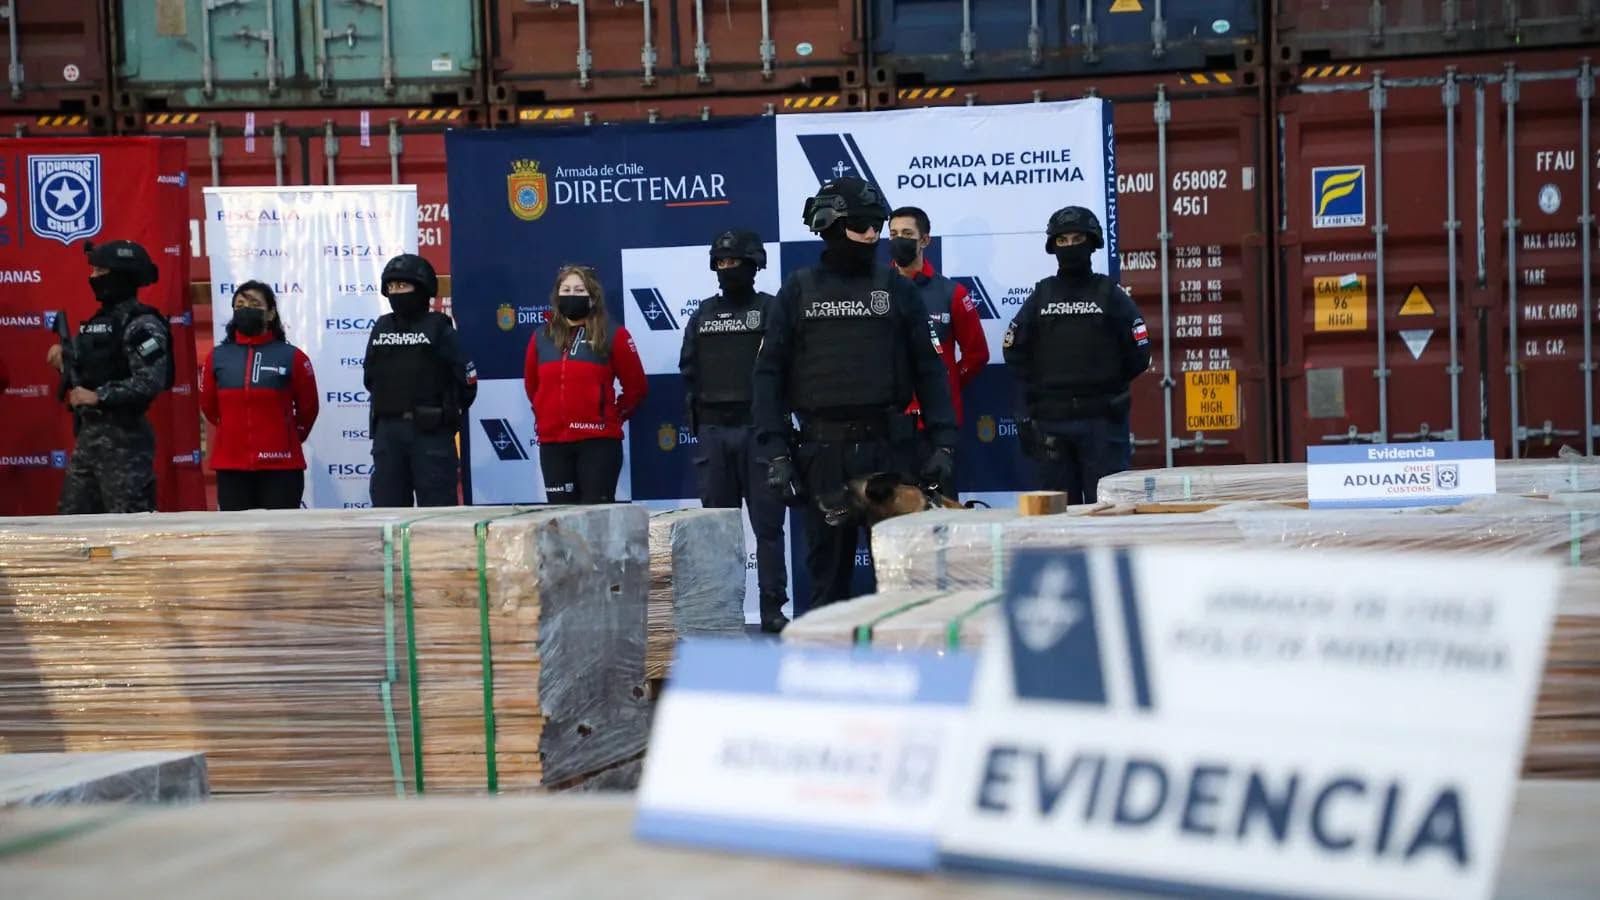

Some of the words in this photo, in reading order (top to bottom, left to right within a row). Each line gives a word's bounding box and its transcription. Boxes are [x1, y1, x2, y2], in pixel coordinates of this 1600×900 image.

[908, 154, 987, 170] ARMADA
[992, 153, 1015, 166] DE
[1020, 149, 1071, 164] CHILE
[1536, 151, 1575, 171] FFAU
[555, 165, 598, 177] Armada
[601, 164, 614, 176] de
[616, 163, 644, 175] Chile
[898, 172, 977, 189] POLICIA
[984, 167, 1084, 186] MARITIMA
[1117, 173, 1154, 193] GAOU
[1172, 169, 1227, 191] 658082
[554, 173, 727, 205] DIRECTEMAR
[1107, 123, 1117, 257] MARITIMAS
[1172, 195, 1208, 215] 45G1
[418, 226, 442, 246] 5G1
[1548, 232, 1576, 249] GROSS
[1120, 251, 1156, 271] X.GROSS
[1208, 257, 1222, 267] LBS
[1304, 251, 1376, 263] www.florens.co
[1207, 280, 1221, 290] KGS
[811, 301, 865, 310] POLICIA
[1040, 307, 1104, 315] MARITIMA
[1549, 303, 1578, 320] CARGO
[805, 308, 872, 318] MARITIMA
[1328, 313, 1353, 326] HIGH
[0, 316, 41, 326] UANAS
[699, 324, 747, 333] MARITIMA
[1208, 326, 1222, 336] LBS
[372, 337, 431, 346] MARITIMA
[379, 332, 426, 340] POLICIA
[1546, 339, 1566, 356] CAP.
[1191, 374, 1230, 385] CAUTION
[1200, 402, 1223, 414] HIGH
[0, 454, 48, 465] DUANAS
[1367, 446, 1435, 460] Evidencia
[1403, 464, 1431, 473] CHILE
[1343, 473, 1431, 487] ADUANAS
[1387, 486, 1432, 494] CUSTOMS
[974, 741, 1470, 868] EVIDENCIA
